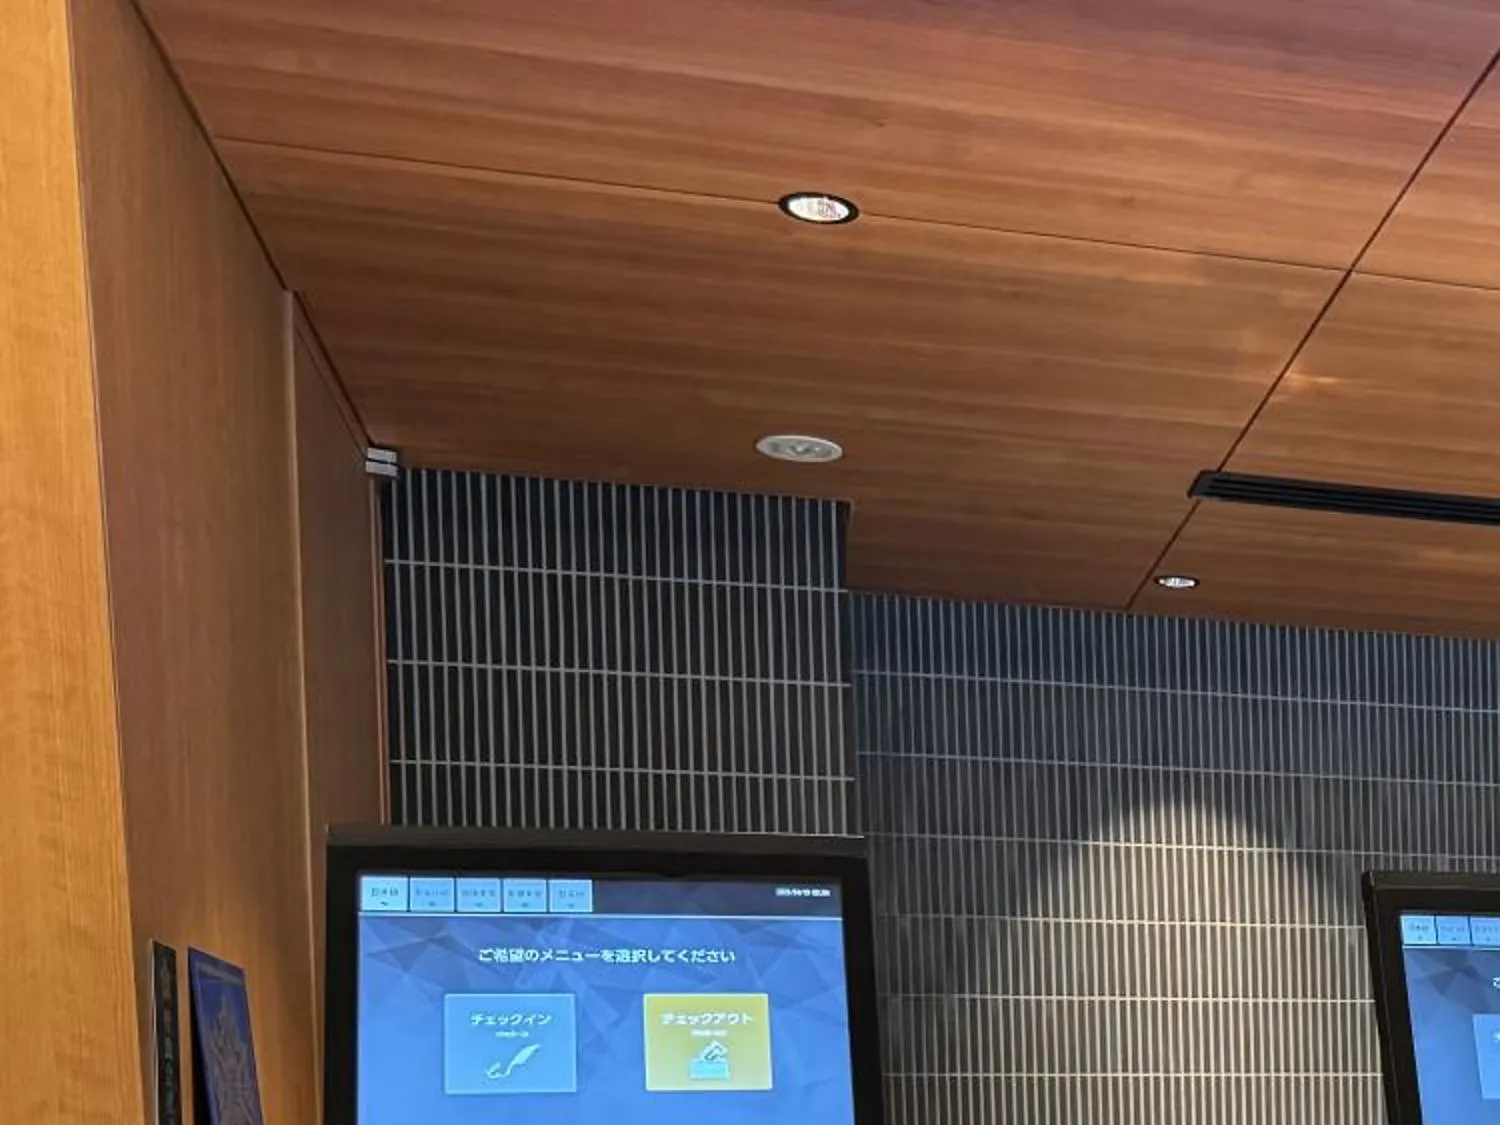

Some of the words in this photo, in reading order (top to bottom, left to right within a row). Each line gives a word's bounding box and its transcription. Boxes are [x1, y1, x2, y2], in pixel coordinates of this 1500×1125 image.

[478, 948, 736, 964] ご希望のメニューを選択してください
[470, 1013, 552, 1026] チェックイン
[662, 1011, 754, 1025] チェックアウト
